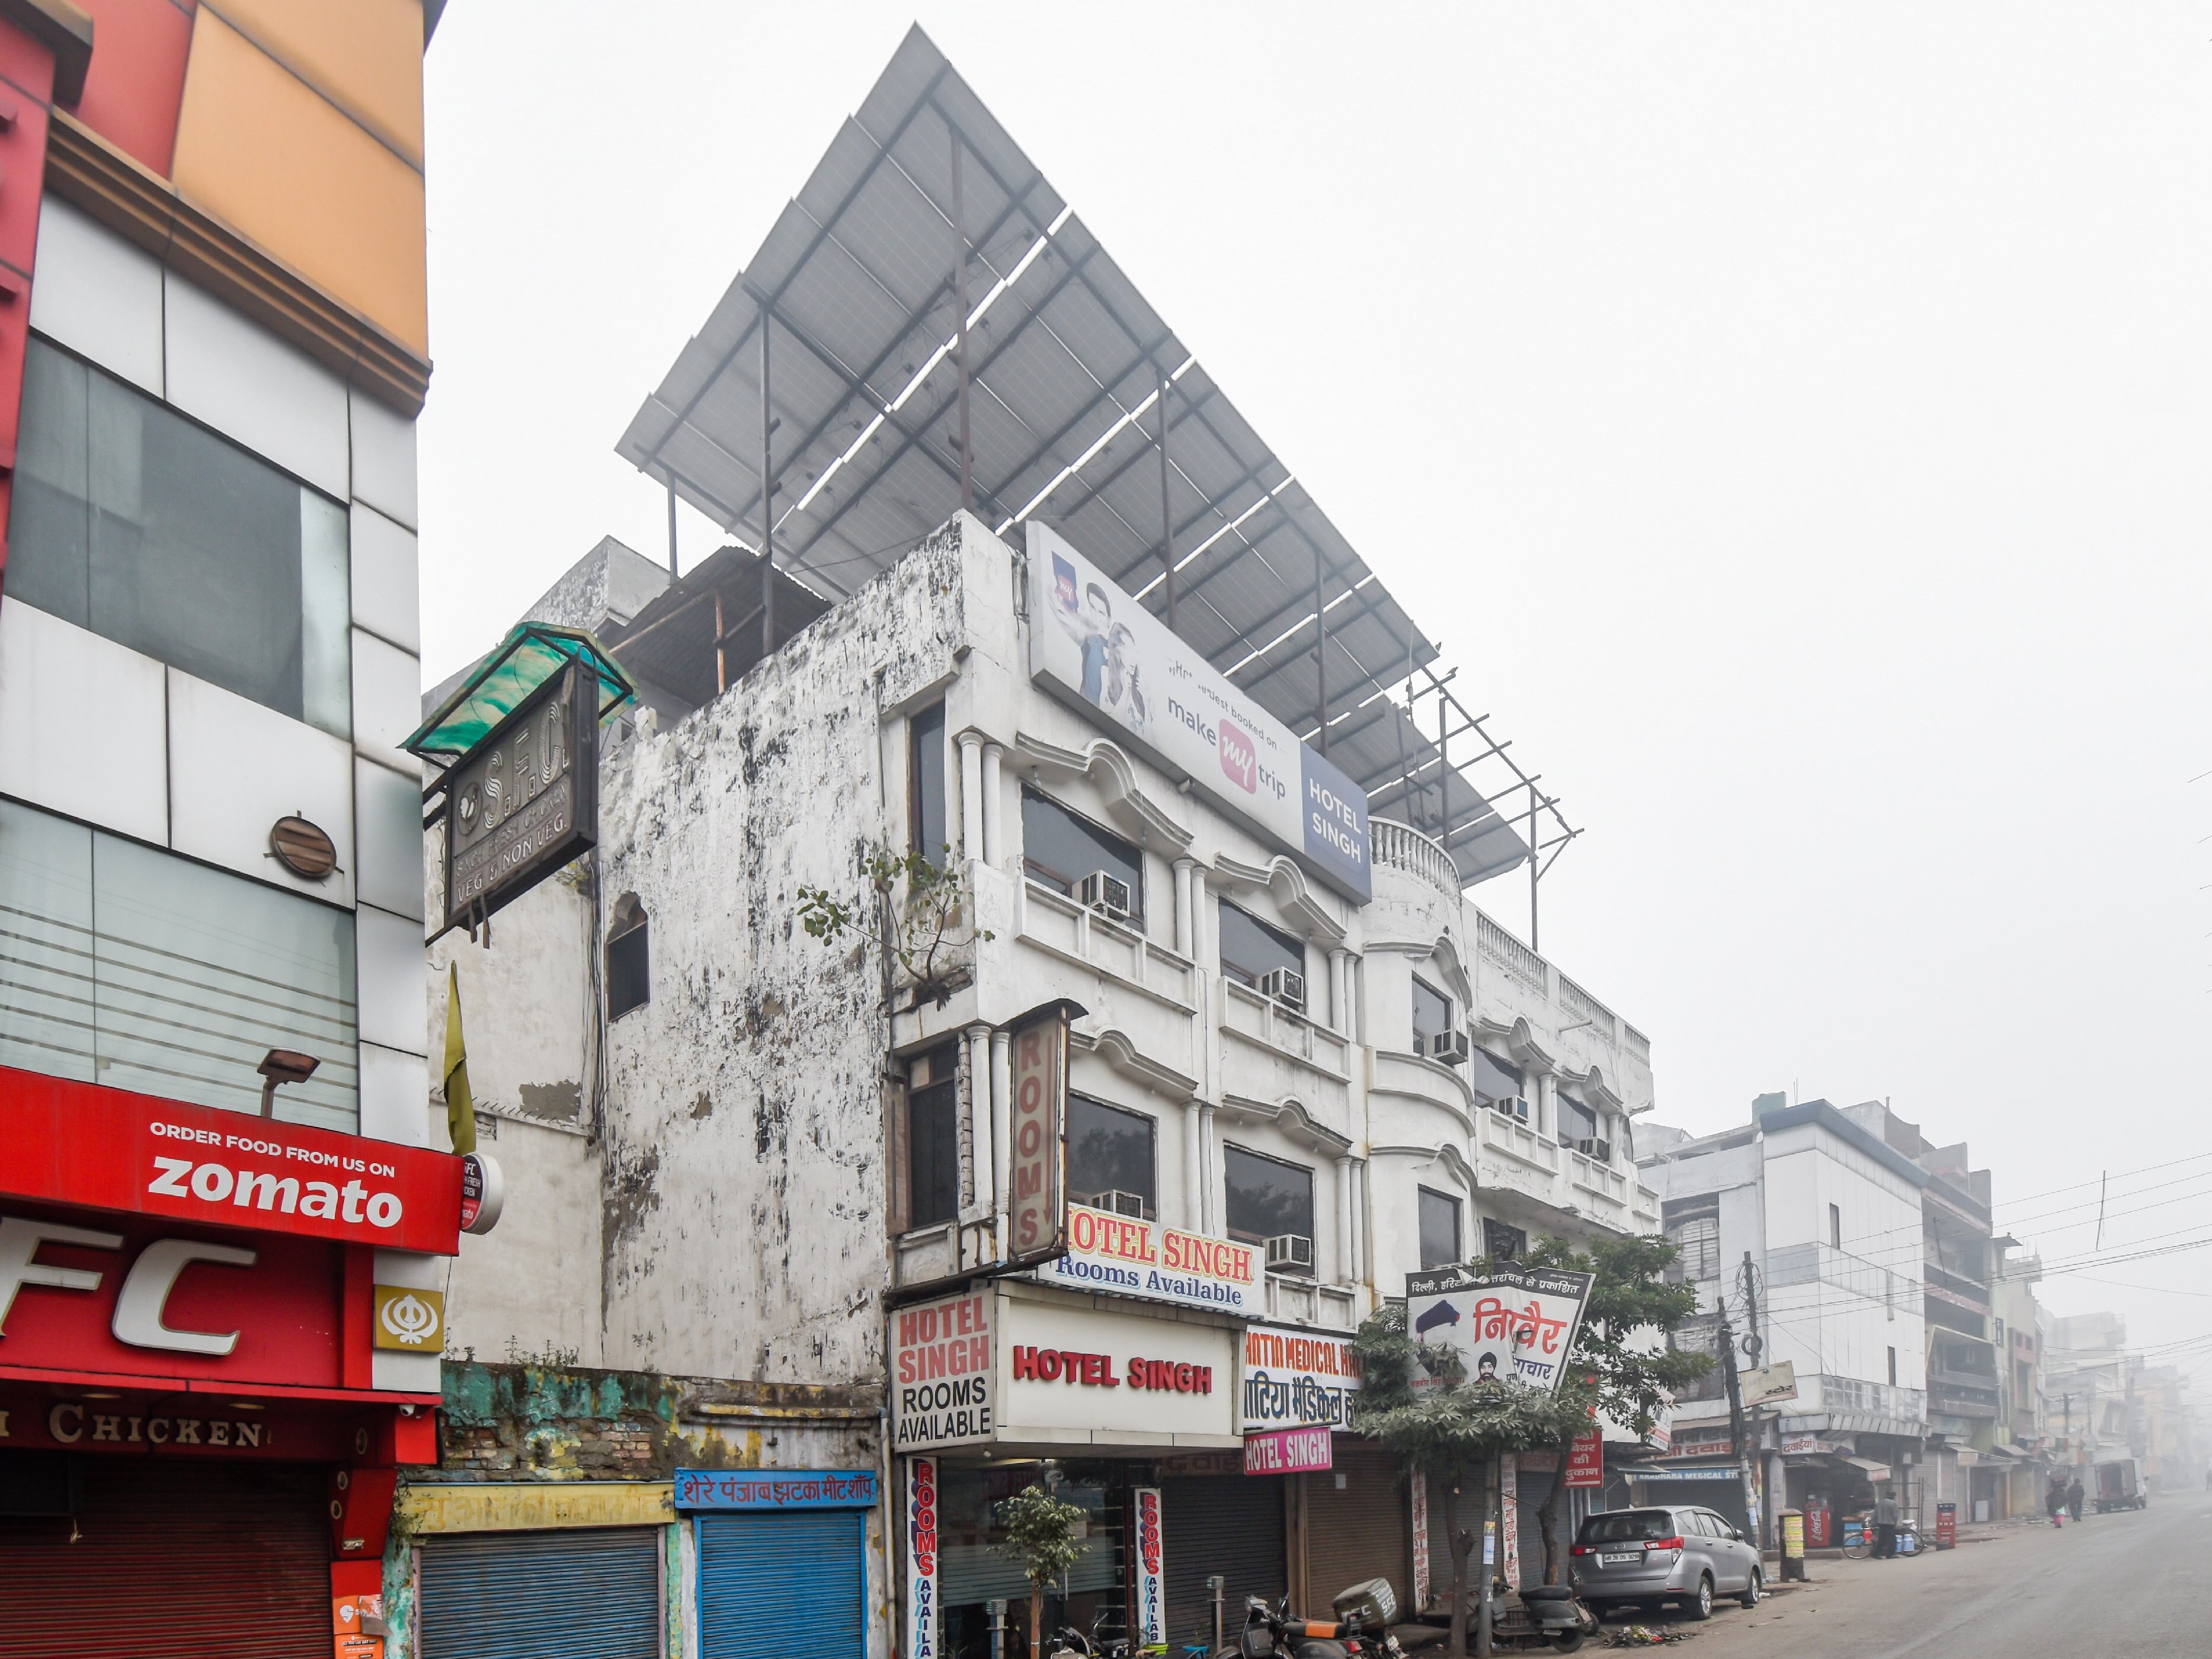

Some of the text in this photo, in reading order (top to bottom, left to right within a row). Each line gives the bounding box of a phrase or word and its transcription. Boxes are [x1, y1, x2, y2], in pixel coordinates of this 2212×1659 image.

[1168, 696, 1286, 800] make my trip
[1231, 705, 1265, 741] booked
[1266, 736, 1278, 751] on
[1309, 777, 1362, 835] HOTEL
[502, 836, 533, 872] NON
[537, 811, 568, 847] VEG.
[1312, 812, 1362, 864] SINGH
[149, 1122, 395, 1178] ORDER FOOD FROM US ON
[1017, 1031, 1042, 1245] ROOMS
[148, 1155, 403, 1228] zomato
[468, 1176, 481, 1188] FRESH
[1067, 1209, 1251, 1282] OTEL SINGH
[1055, 1251, 1243, 1305] Rooms Available
[899, 1296, 988, 1347] HOTEL
[898, 1335, 990, 1384] SINGH
[1013, 1346, 1212, 1394] HOTEL SINGH
[1285, 1336, 1339, 1376] MEDICAL
[902, 1376, 987, 1414] ROOMS
[49, 1403, 261, 1447] CHICKEN
[898, 1407, 991, 1444] AVAILABLE
[1246, 1437, 1282, 1471] HOTEL
[1286, 1433, 1328, 1468] SINGH
[1565, 1468, 1599, 1480] दुकान
[1573, 1454, 1589, 1463] की
[683, 1474, 716, 1504] शेरे
[719, 1476, 771, 1503] पंजाब
[773, 1481, 821, 1506] झटका
[821, 1474, 847, 1500] मीट
[912, 1459, 936, 1577] ROOMS
[1139, 1493, 1160, 1575] ROOMS
[1811, 1510, 1823, 1541] Coca-Cola
[1381, 1594, 1397, 1614] SFC
